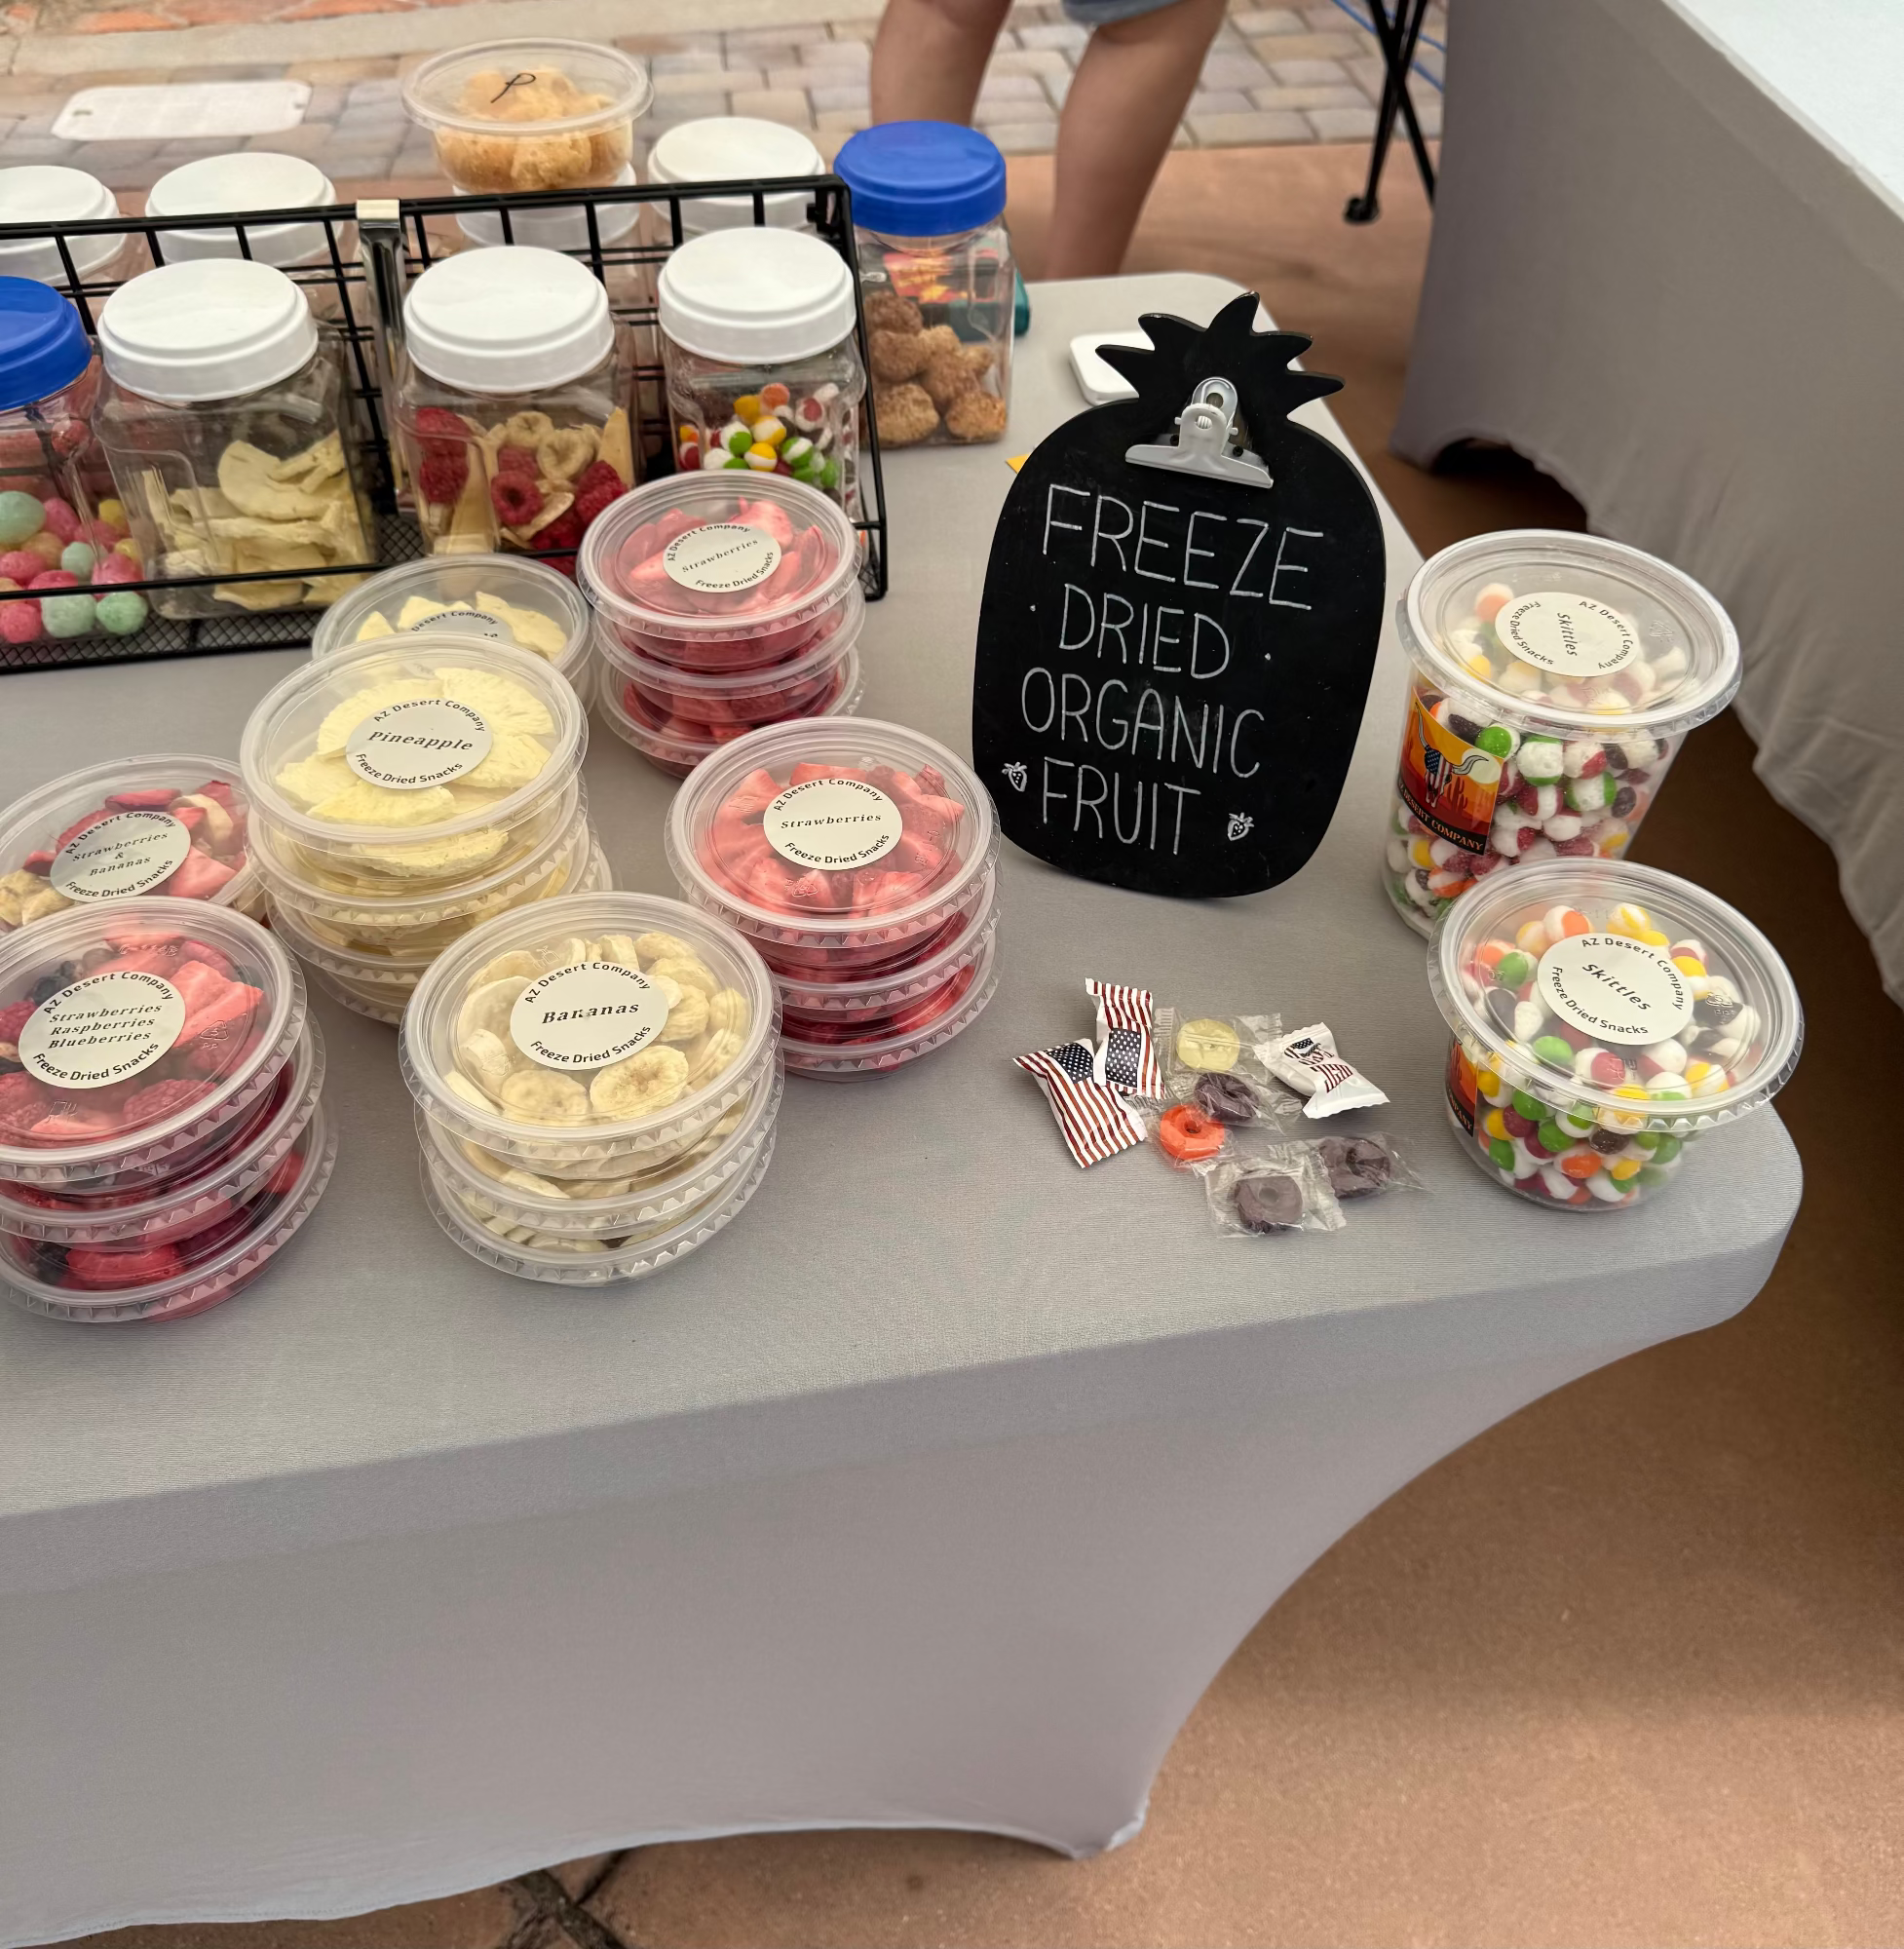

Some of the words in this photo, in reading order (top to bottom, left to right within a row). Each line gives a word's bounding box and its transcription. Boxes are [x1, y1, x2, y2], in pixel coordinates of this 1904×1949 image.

[669, 530, 698, 552] Desert
[700, 524, 750, 533] Company
[667, 553, 676, 562] AZ
[682, 539, 758, 573] Strawberries
[1043, 483, 1324, 610] FREEZE
[696, 579, 731, 589] Freeze
[732, 572, 758, 587] Dried
[757, 552, 774, 575] Snacks
[1511, 601, 1542, 620] Freeze
[1579, 600, 1597, 611] AZ
[411, 613, 447, 632] Desert
[451, 611, 498, 625] Company
[1058, 583, 1230, 679] DRIED
[1510, 620, 1524, 641] Dried
[1557, 612, 1578, 657] Skittles
[1599, 609, 1631, 637] Desert
[1517, 640, 1554, 666] Snacks
[1598, 639, 1634, 669] Company
[373, 711, 391, 723] AZ
[393, 699, 441, 713] Desert
[445, 700, 485, 732] Company
[1021, 667, 1265, 779] ORGANIC
[367, 731, 474, 750] Pineapple
[356, 753, 382, 778] Freeze
[382, 773, 416, 784] Dried
[419, 762, 463, 783] Snacks
[774, 799, 786, 812] AZ
[782, 780, 824, 800] Desert
[828, 779, 883, 802] Company
[1043, 756, 1201, 856] FRUIT
[65, 842, 80, 855] AZ
[77, 815, 121, 841] Desert
[126, 812, 176, 828] Company
[781, 814, 882, 829] Strawberries
[1403, 789, 1430, 822] DESERT
[1431, 820, 1483, 851] COMPANY
[72, 832, 169, 861] Strawberries
[784, 842, 821, 862] Freeze
[824, 853, 858, 864] Dried
[857, 834, 890, 859] Snacks
[65, 881, 99, 898] Freeze
[101, 884, 135, 898] Dried
[136, 860, 173, 888] Snacks
[89, 856, 151, 877] Bananas
[524, 988, 541, 1004] AZ
[538, 963, 587, 987] Desert
[592, 962, 651, 990] Company
[1581, 937, 1600, 947] AZ
[1605, 937, 1655, 959] Desert
[1656, 960, 1684, 1011] Company
[1582, 964, 1652, 1011] Skittles
[43, 999, 62, 1014] AZ
[61, 973, 115, 998] Desert
[121, 972, 173, 1001] Company
[1551, 966, 1568, 1000] Freeze
[1566, 999, 1598, 1024] Dried
[1600, 1019, 1649, 1034] Snacks
[49, 1005, 163, 1023] Strawberries
[50, 1017, 156, 1036] Raspberries
[542, 1004, 639, 1024] Bananas
[48, 1029, 152, 1050] Blueberries
[530, 1040, 570, 1063] Freeze
[573, 1050, 611, 1063] Dried
[612, 1025, 651, 1054] Snacks
[32, 1052, 68, 1080] Freeze
[69, 1069, 110, 1081] Dried
[112, 1042, 159, 1075] Snacks
